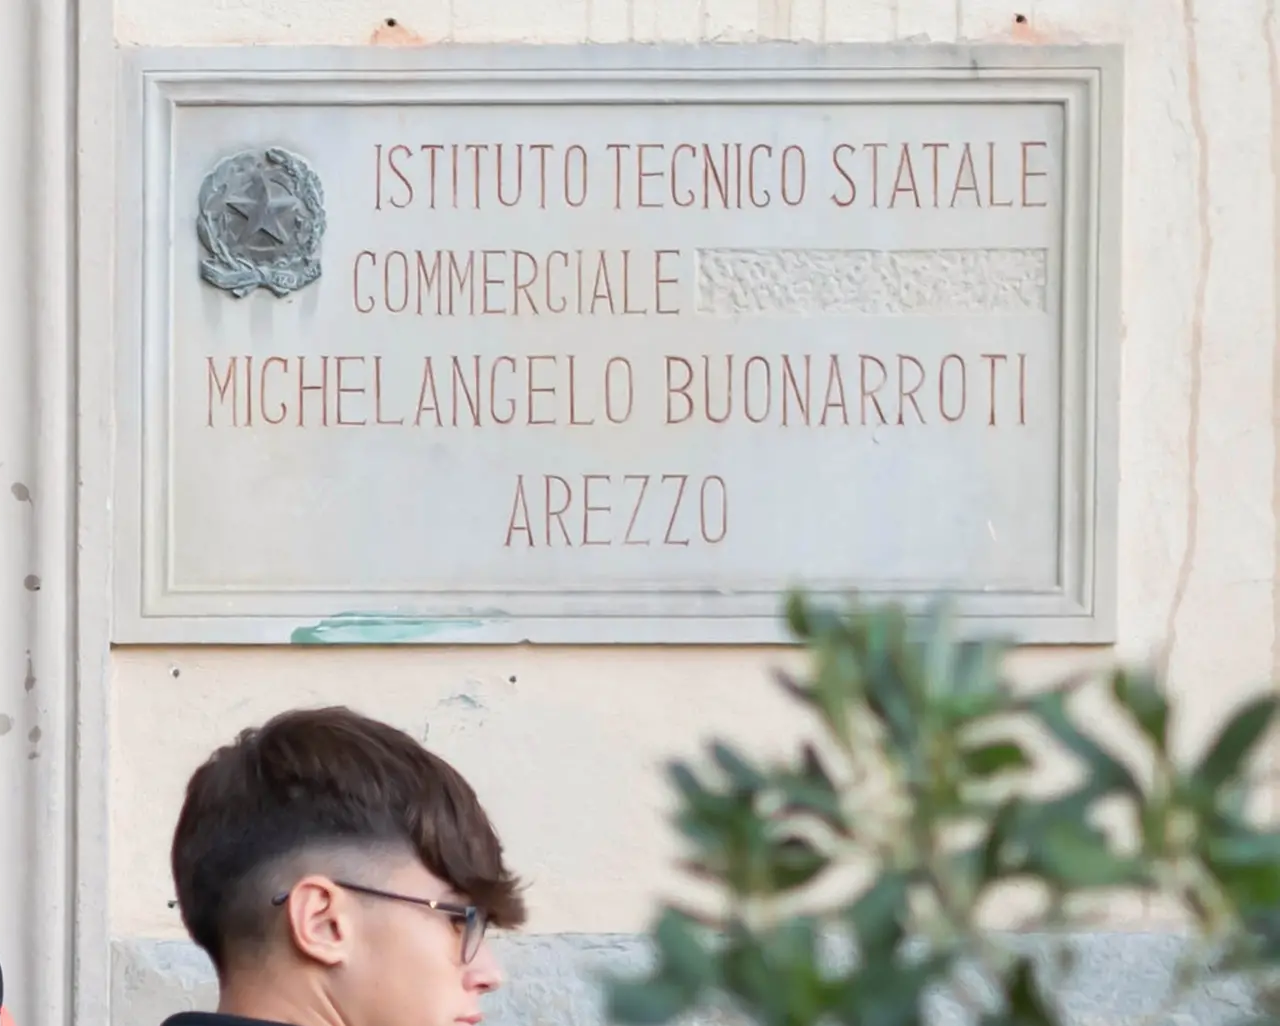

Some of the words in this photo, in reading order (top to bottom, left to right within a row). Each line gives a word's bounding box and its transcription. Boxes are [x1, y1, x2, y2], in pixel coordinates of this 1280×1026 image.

[373, 143, 589, 211] ISTITUTO
[606, 143, 808, 211] TECNICO
[831, 141, 1049, 210] STATALE
[352, 249, 682, 318] COMMERCIALE
[205, 355, 634, 429] MICHELANGELO
[664, 353, 1029, 428] BUONARROTI
[504, 474, 730, 549] AREZZO
